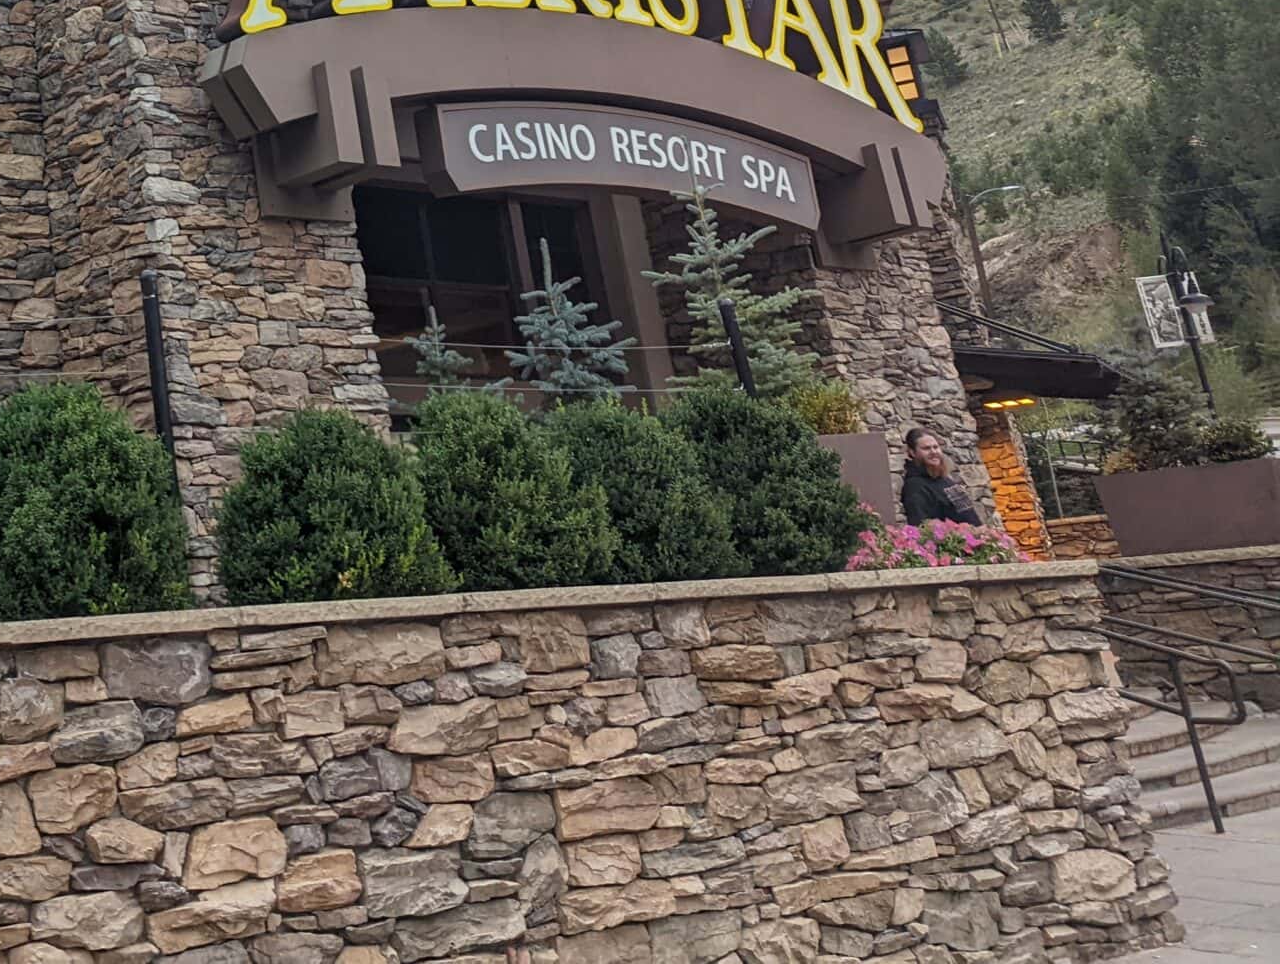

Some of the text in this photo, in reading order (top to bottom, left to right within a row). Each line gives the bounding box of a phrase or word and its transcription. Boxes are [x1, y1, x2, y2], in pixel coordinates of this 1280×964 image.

[468, 121, 797, 204] CASINO RESORT SPA
